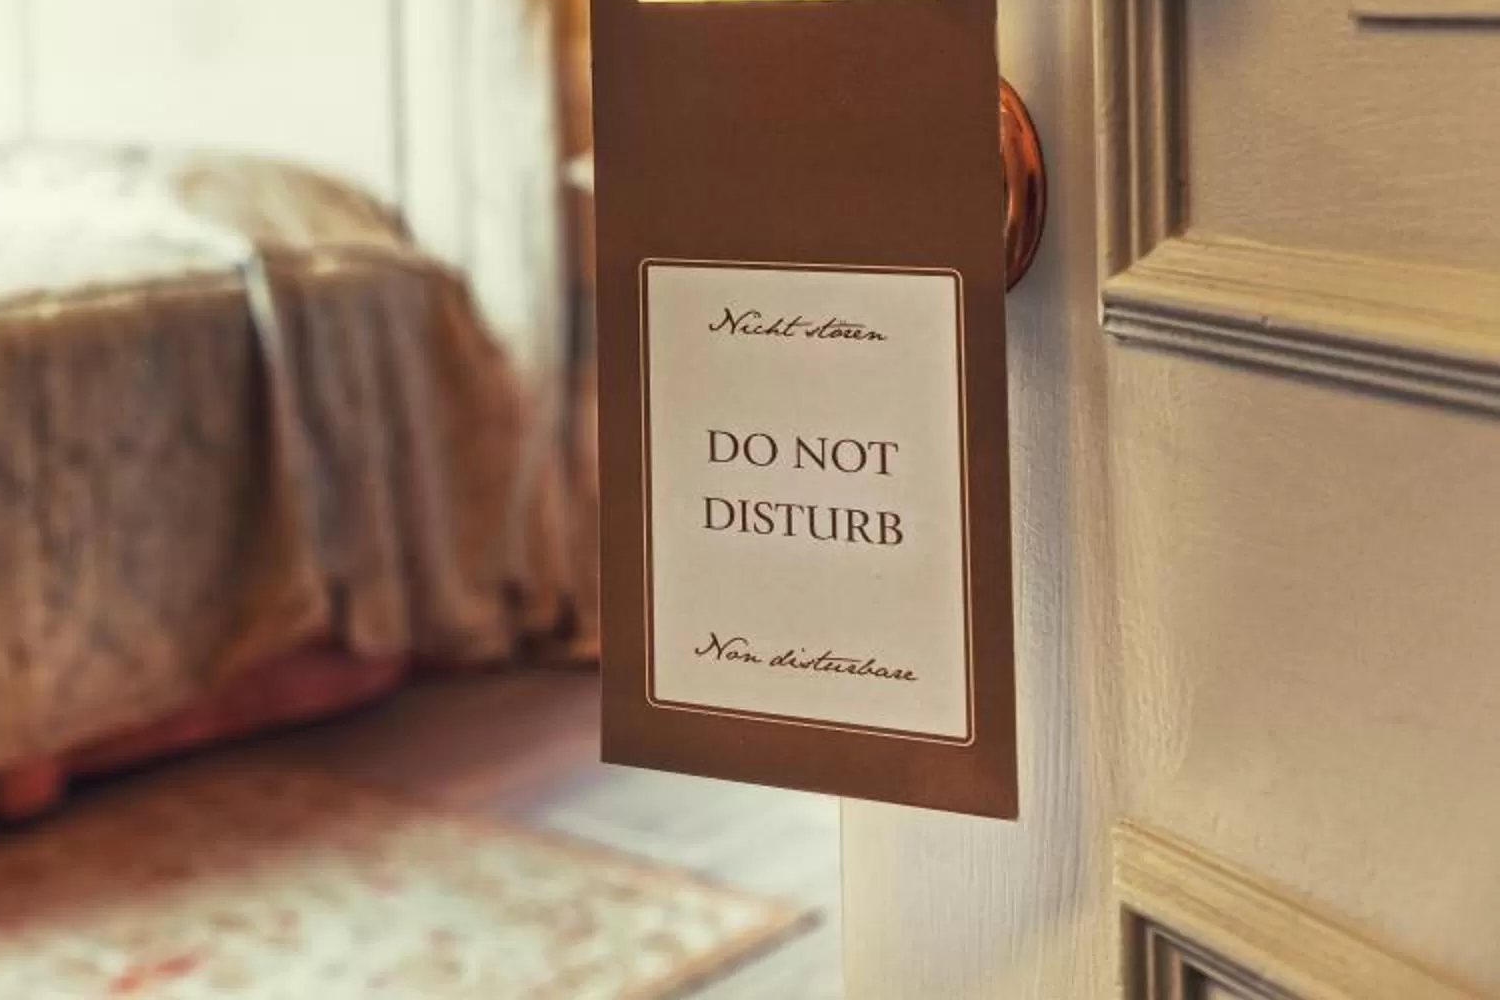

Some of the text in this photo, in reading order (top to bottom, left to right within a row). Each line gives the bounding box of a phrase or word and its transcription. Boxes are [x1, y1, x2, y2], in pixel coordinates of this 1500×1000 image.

[708, 307, 811, 338] Nicht
[707, 429, 899, 476] DO NOT
[703, 497, 904, 546] DISTURB
[694, 631, 919, 682] Non disturbare
